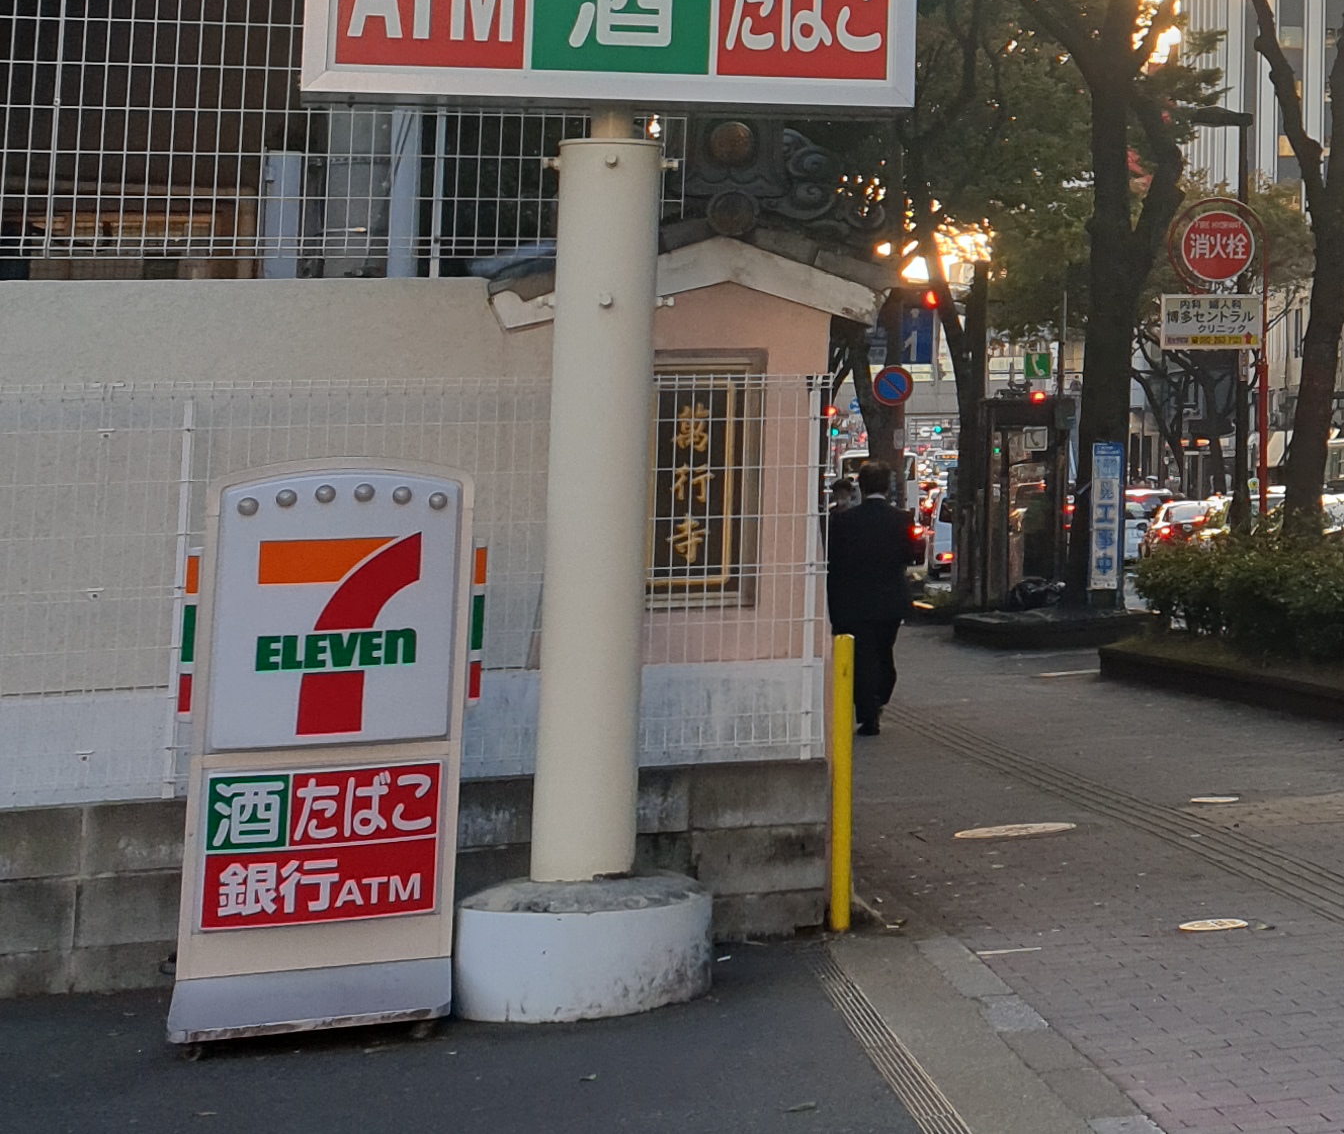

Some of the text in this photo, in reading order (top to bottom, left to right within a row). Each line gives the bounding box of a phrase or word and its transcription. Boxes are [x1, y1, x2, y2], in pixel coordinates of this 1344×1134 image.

[1190, 232, 1248, 259] 消火栓
[1166, 310, 1255, 324] 博多セントラル
[1198, 324, 1246, 334] クリニック
[212, 770, 433, 848] 酒 たばこ
